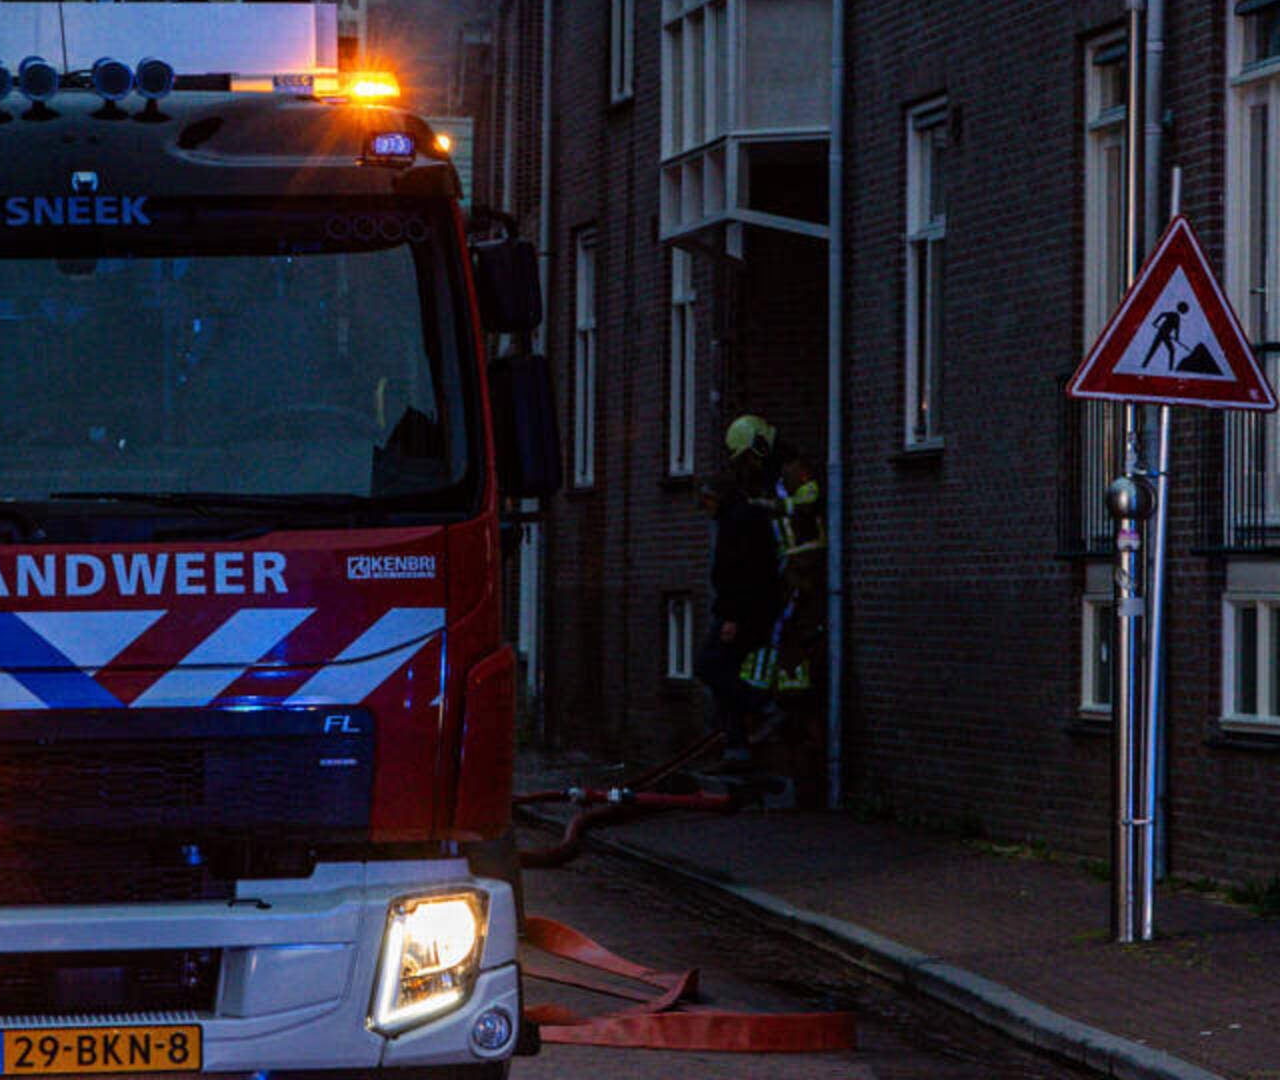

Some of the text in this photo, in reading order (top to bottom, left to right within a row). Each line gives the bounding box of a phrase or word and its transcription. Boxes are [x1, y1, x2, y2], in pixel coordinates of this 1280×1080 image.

[5, 195, 152, 226] SNEEK
[371, 555, 436, 572] KENBRI
[323, 715, 360, 734] FL
[13, 1031, 190, 1069] 29-BKN-8
